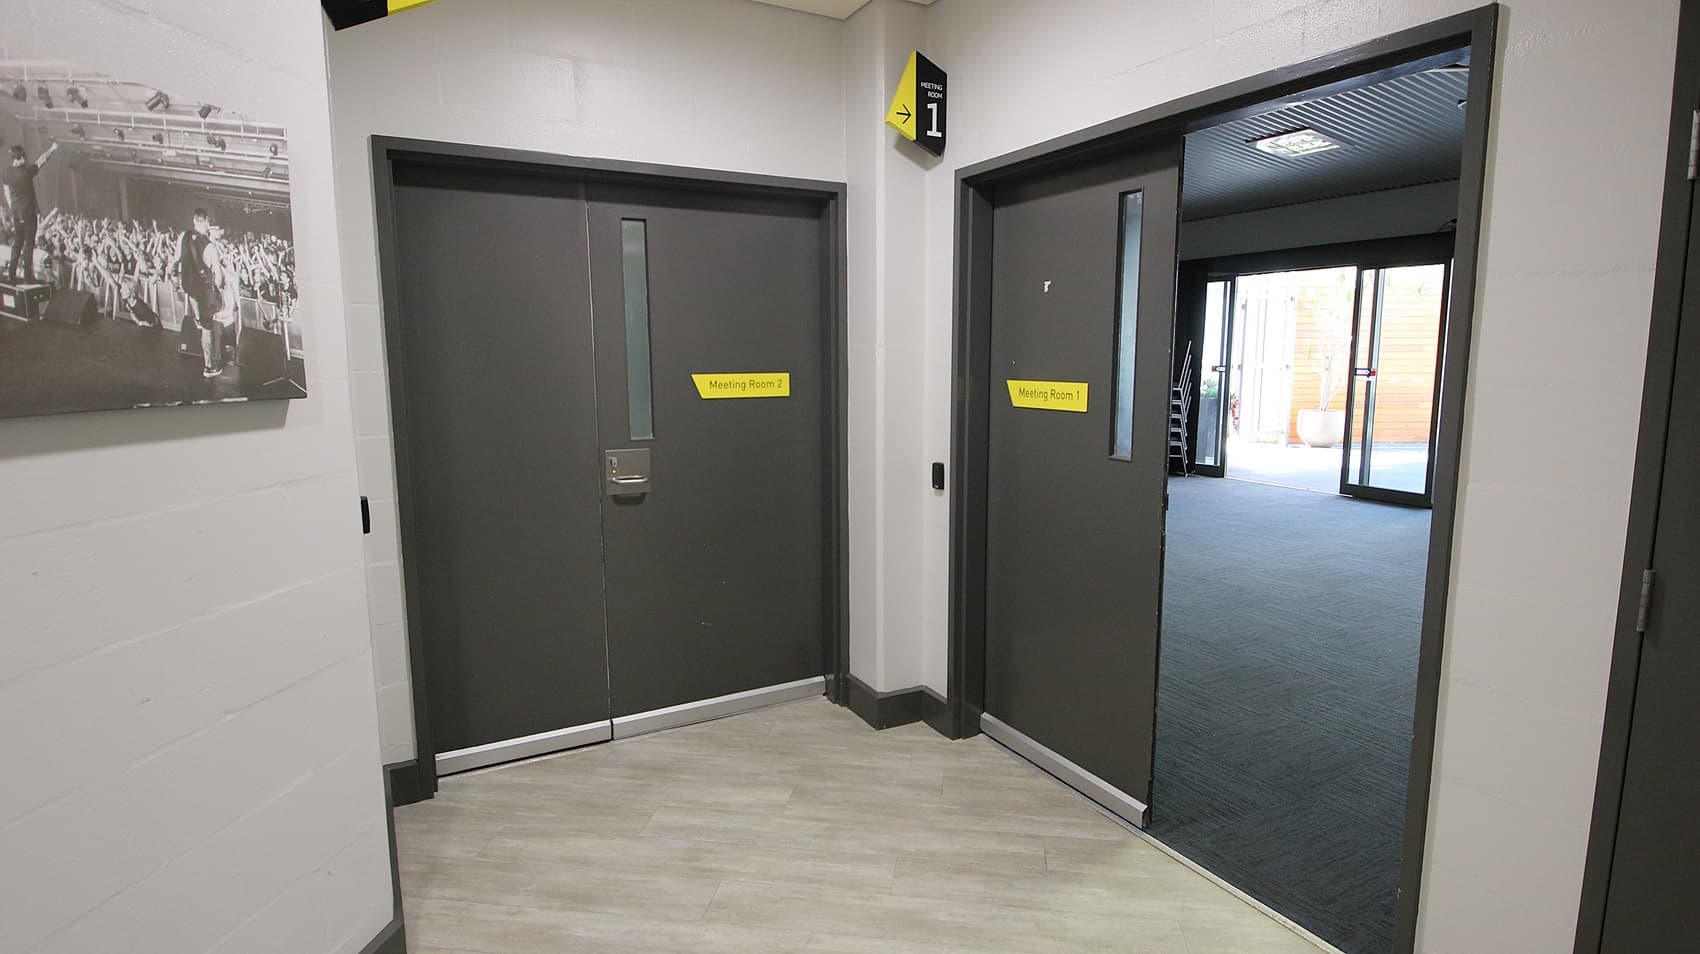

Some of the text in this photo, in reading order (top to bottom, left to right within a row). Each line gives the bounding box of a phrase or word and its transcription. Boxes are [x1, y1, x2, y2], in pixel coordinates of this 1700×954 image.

[921, 81, 943, 90] MEETING
[927, 91, 943, 99] ROOM
[927, 103, 942, 137] 1
[709, 379, 783, 391] Meeting Room 2
[1019, 387, 1080, 401] Meeting Room 1
